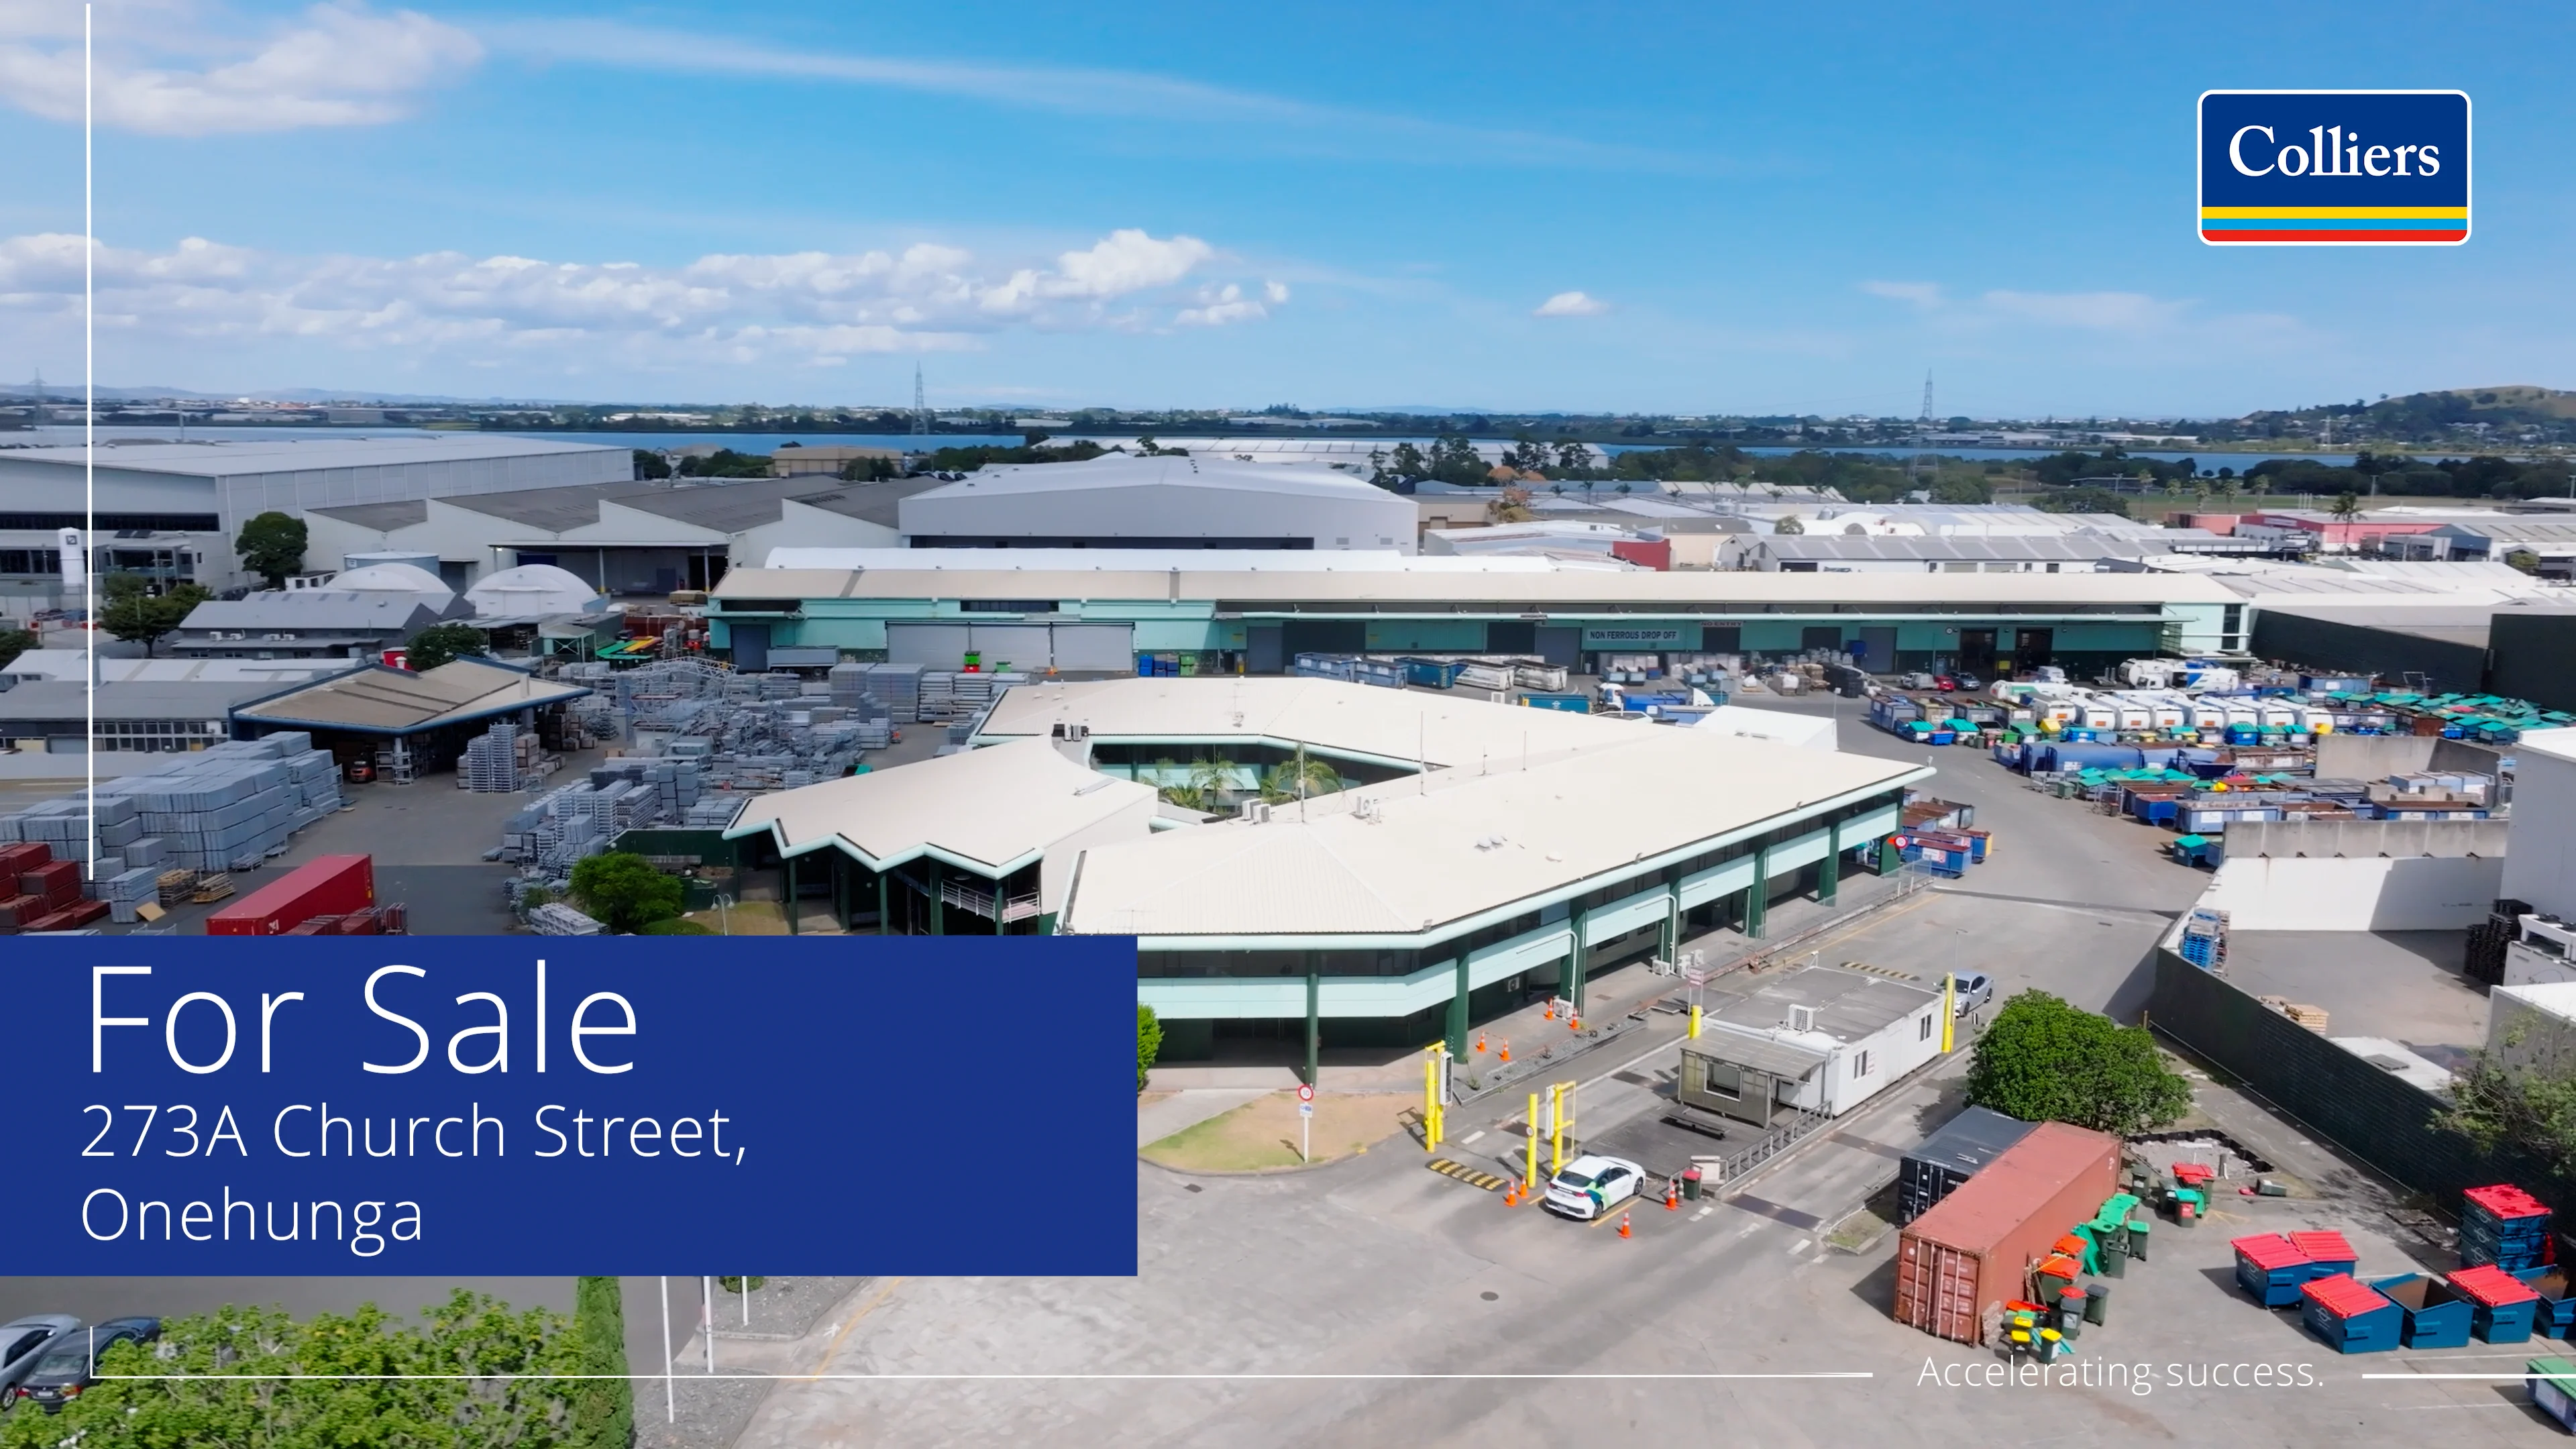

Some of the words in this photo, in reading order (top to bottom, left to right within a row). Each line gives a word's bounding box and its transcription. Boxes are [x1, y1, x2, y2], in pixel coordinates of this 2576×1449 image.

[1590, 631, 1605, 639] NON
[1607, 631, 1640, 639] FERROUS
[1642, 631, 1661, 639] DROP
[1664, 631, 1676, 639] OFF
